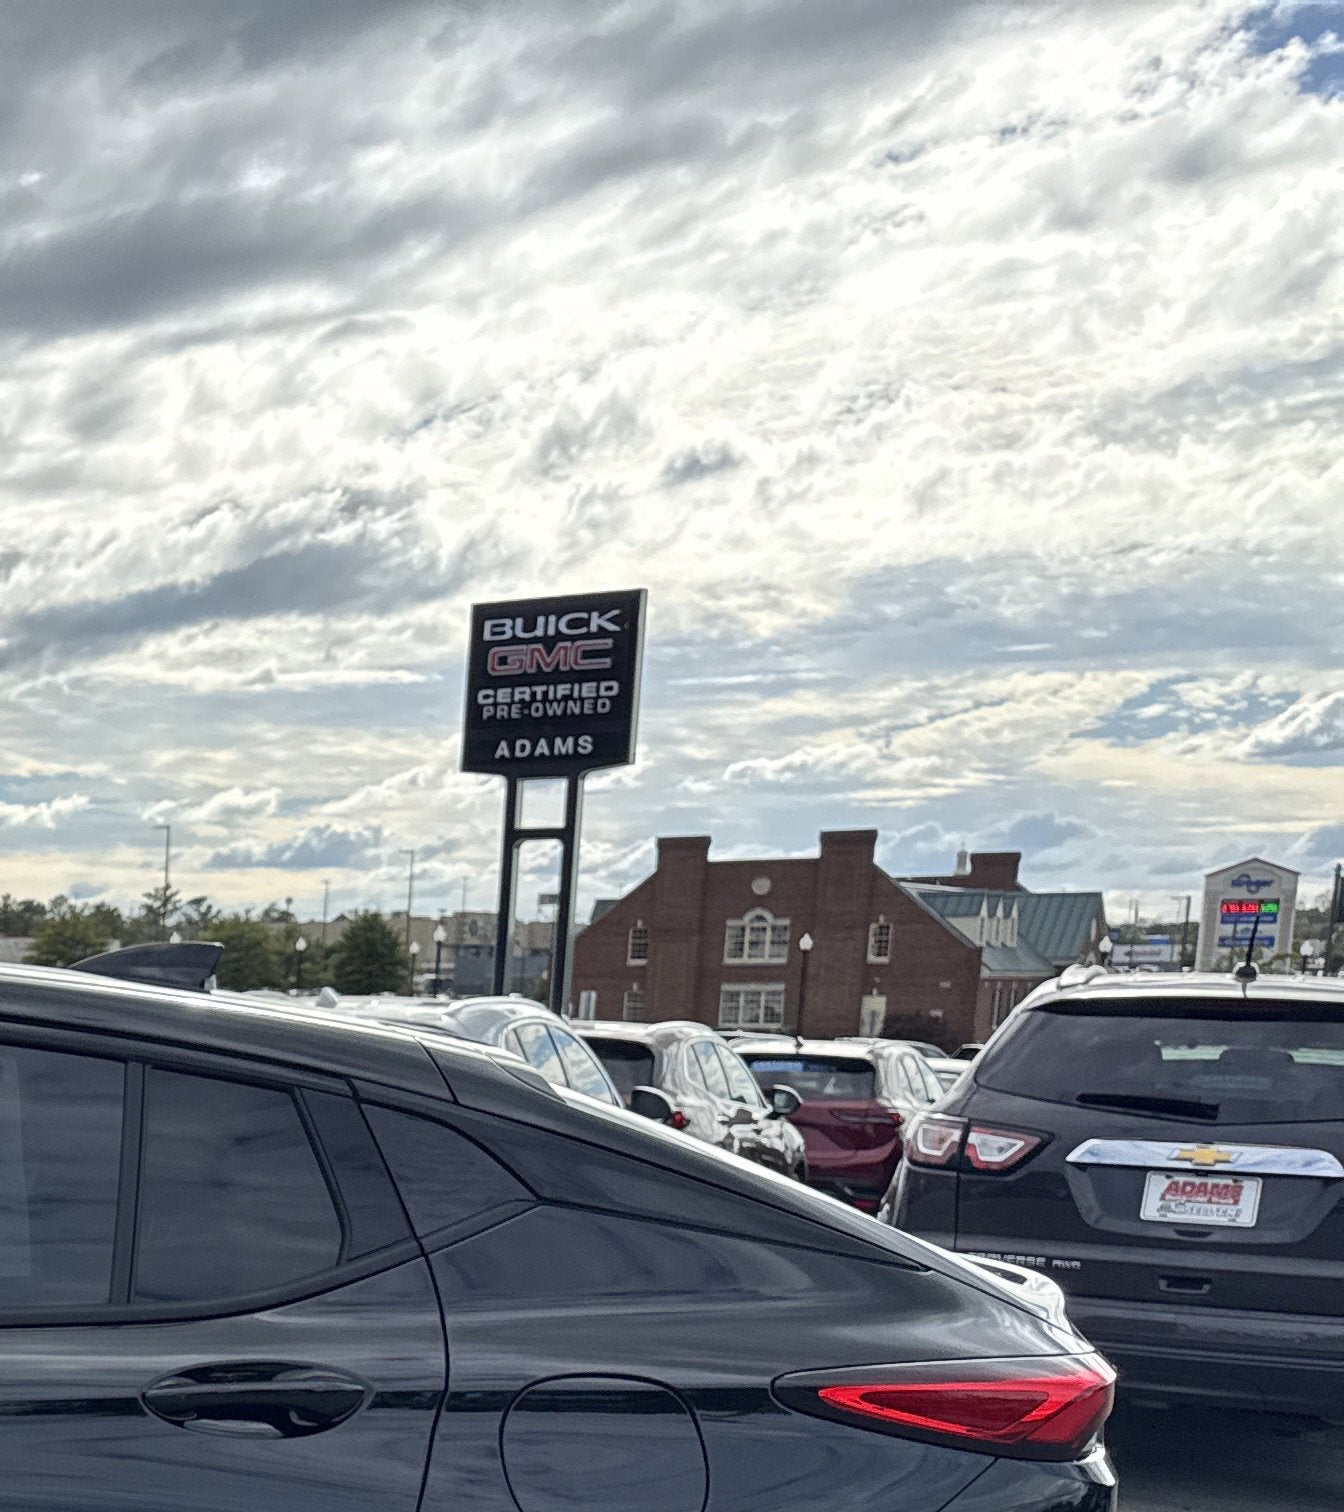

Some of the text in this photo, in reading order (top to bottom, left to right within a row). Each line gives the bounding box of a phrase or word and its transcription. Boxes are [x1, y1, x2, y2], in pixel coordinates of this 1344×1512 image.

[483, 609, 621, 641] BUICK
[487, 638, 614, 676] GMC
[477, 680, 620, 705] CERTIFIED
[482, 698, 611, 720] PRE-OWNED
[494, 735, 594, 759] ADAMS
[1160, 1180, 1243, 1201] ADAMS
